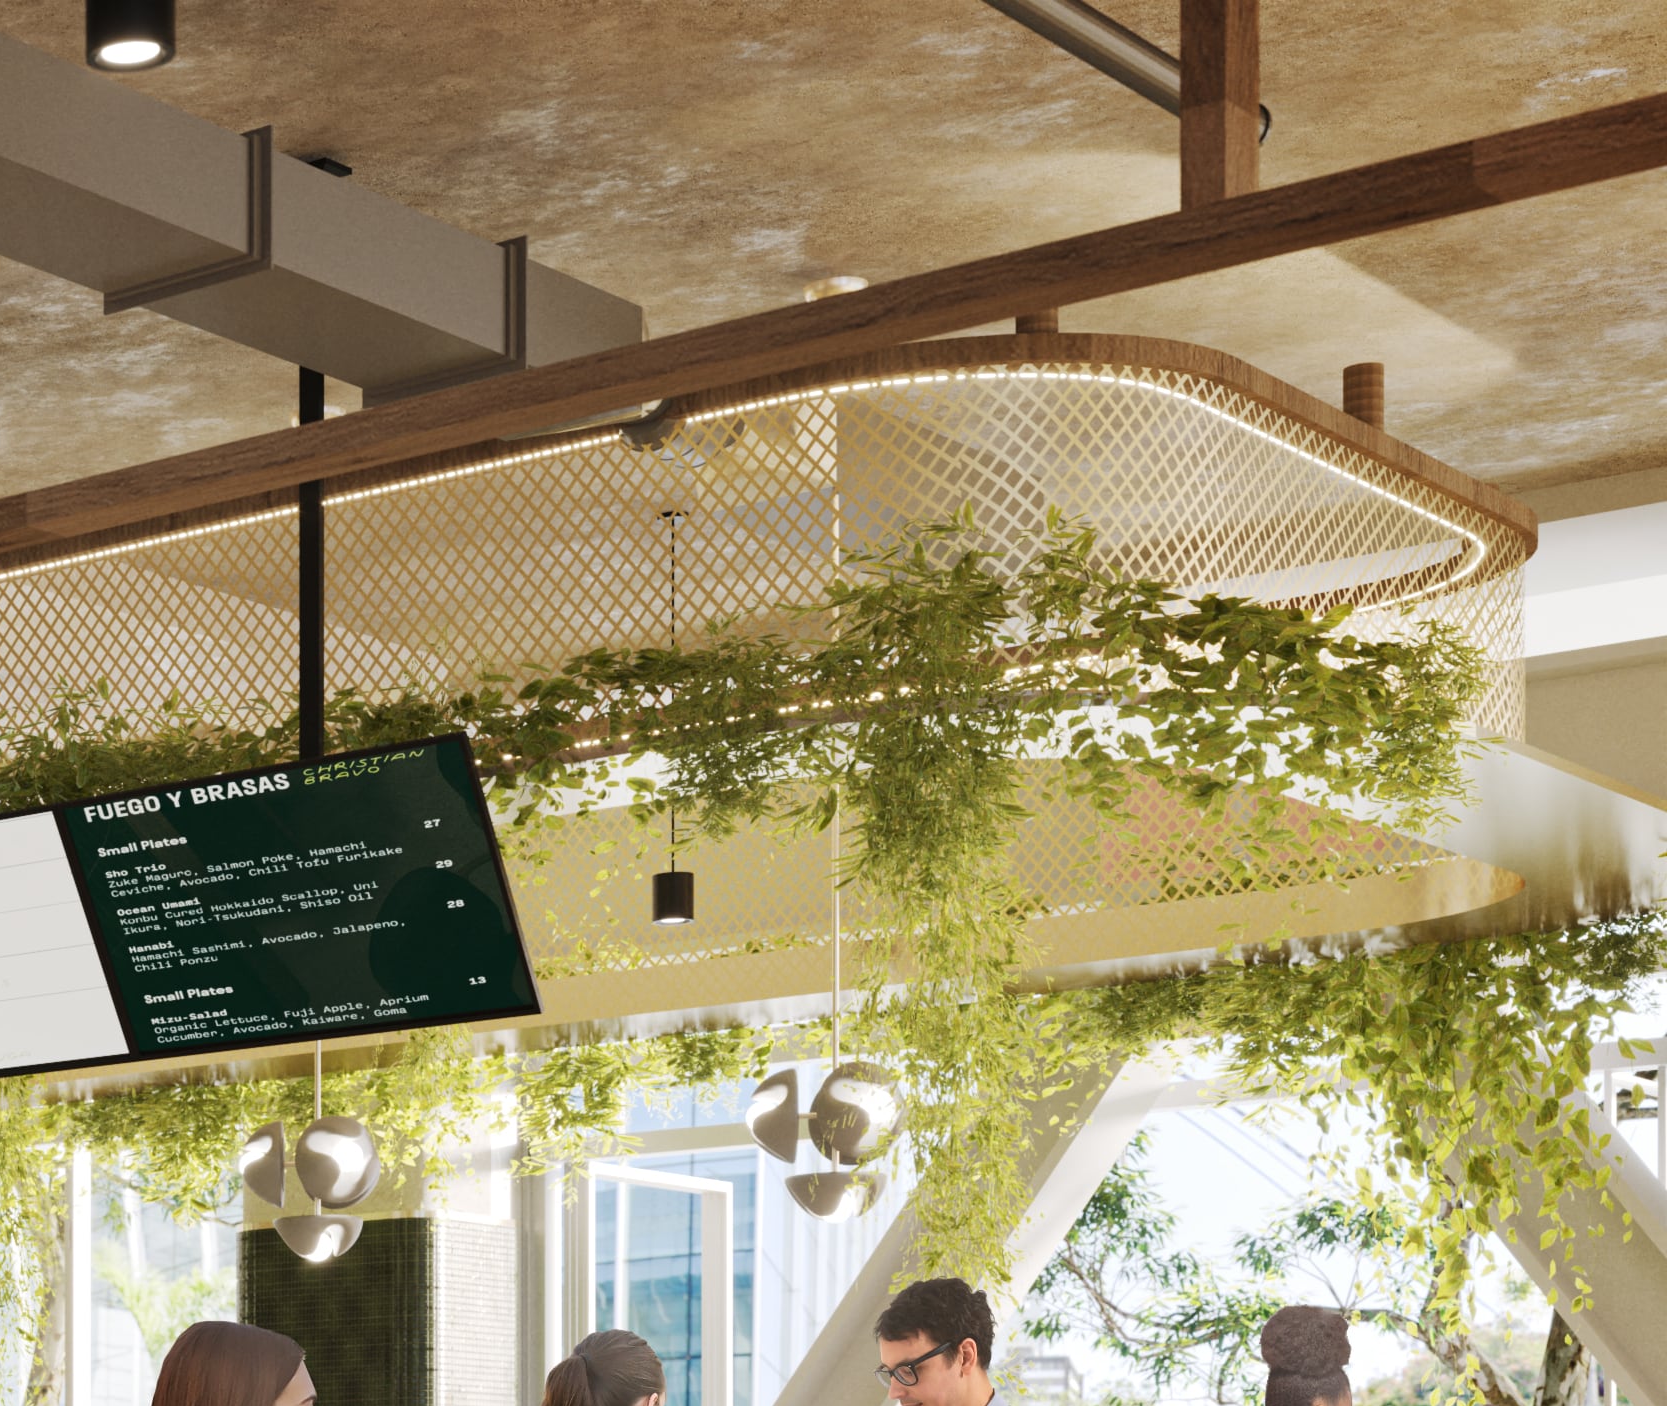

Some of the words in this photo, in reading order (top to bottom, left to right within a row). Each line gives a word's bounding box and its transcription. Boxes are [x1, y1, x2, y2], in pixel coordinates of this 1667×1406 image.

[303, 749, 424, 776] CHRISTIAN
[305, 766, 379, 785] BRAVO
[83, 796, 161, 822] FUEGO
[166, 791, 181, 808] Y
[190, 773, 290, 804] BRASAS
[424, 818, 441, 828] 27
[97, 842, 138, 857] Small
[141, 837, 187, 850] Plates
[105, 870, 128, 878] Sho
[135, 864, 166, 874] Trio
[108, 879, 138, 888] Zuke
[207, 860, 254, 872] Salmon
[262, 854, 300, 864] Poke,
[309, 841, 367, 856] Hamachi
[111, 884, 170, 897] Ceviche,
[180, 874, 239, 887] Avocado,
[249, 864, 288, 876] Chili
[296, 858, 329, 868] Tofu
[337, 848, 403, 862] Furikake
[435, 859, 453, 868] 29
[117, 906, 155, 916] Ocean
[162, 897, 201, 909] Umami
[120, 915, 158, 925] Konbu
[165, 907, 203, 918] Cured
[211, 898, 274, 912] Hokkaido
[282, 888, 344, 901] Scallop,
[353, 881, 379, 891] Uni
[447, 900, 465, 908] 28
[123, 925, 167, 934] Ikura,
[175, 905, 291, 927] Nori-Tsukudani,
[300, 898, 341, 909] Shiso
[348, 892, 373, 902] Oil
[129, 940, 174, 954] Hanabi
[132, 949, 184, 962] Hamachi
[193, 940, 252, 954] Sashimi,
[262, 932, 323, 944] Avocado,
[135, 961, 173, 972] Chili
[180, 956, 218, 966] Ponzu
[469, 976, 486, 985] 13
[144, 990, 184, 1004] Small
[187, 986, 233, 998] Plates
[151, 1009, 227, 1025] Mizu-Salad
[154, 1022, 207, 1034] Organic
[215, 1015, 275, 1026] Lettuce,
[284, 1008, 315, 1018] Fuji
[324, 1003, 369, 1014] Apple,
[380, 995, 429, 1006] Aprium
[157, 1031, 223, 1043] Cucumber,
[233, 1022, 293, 1034] Avocado,
[302, 1014, 364, 1025] Kaiware,
[374, 1008, 407, 1016] Goma
